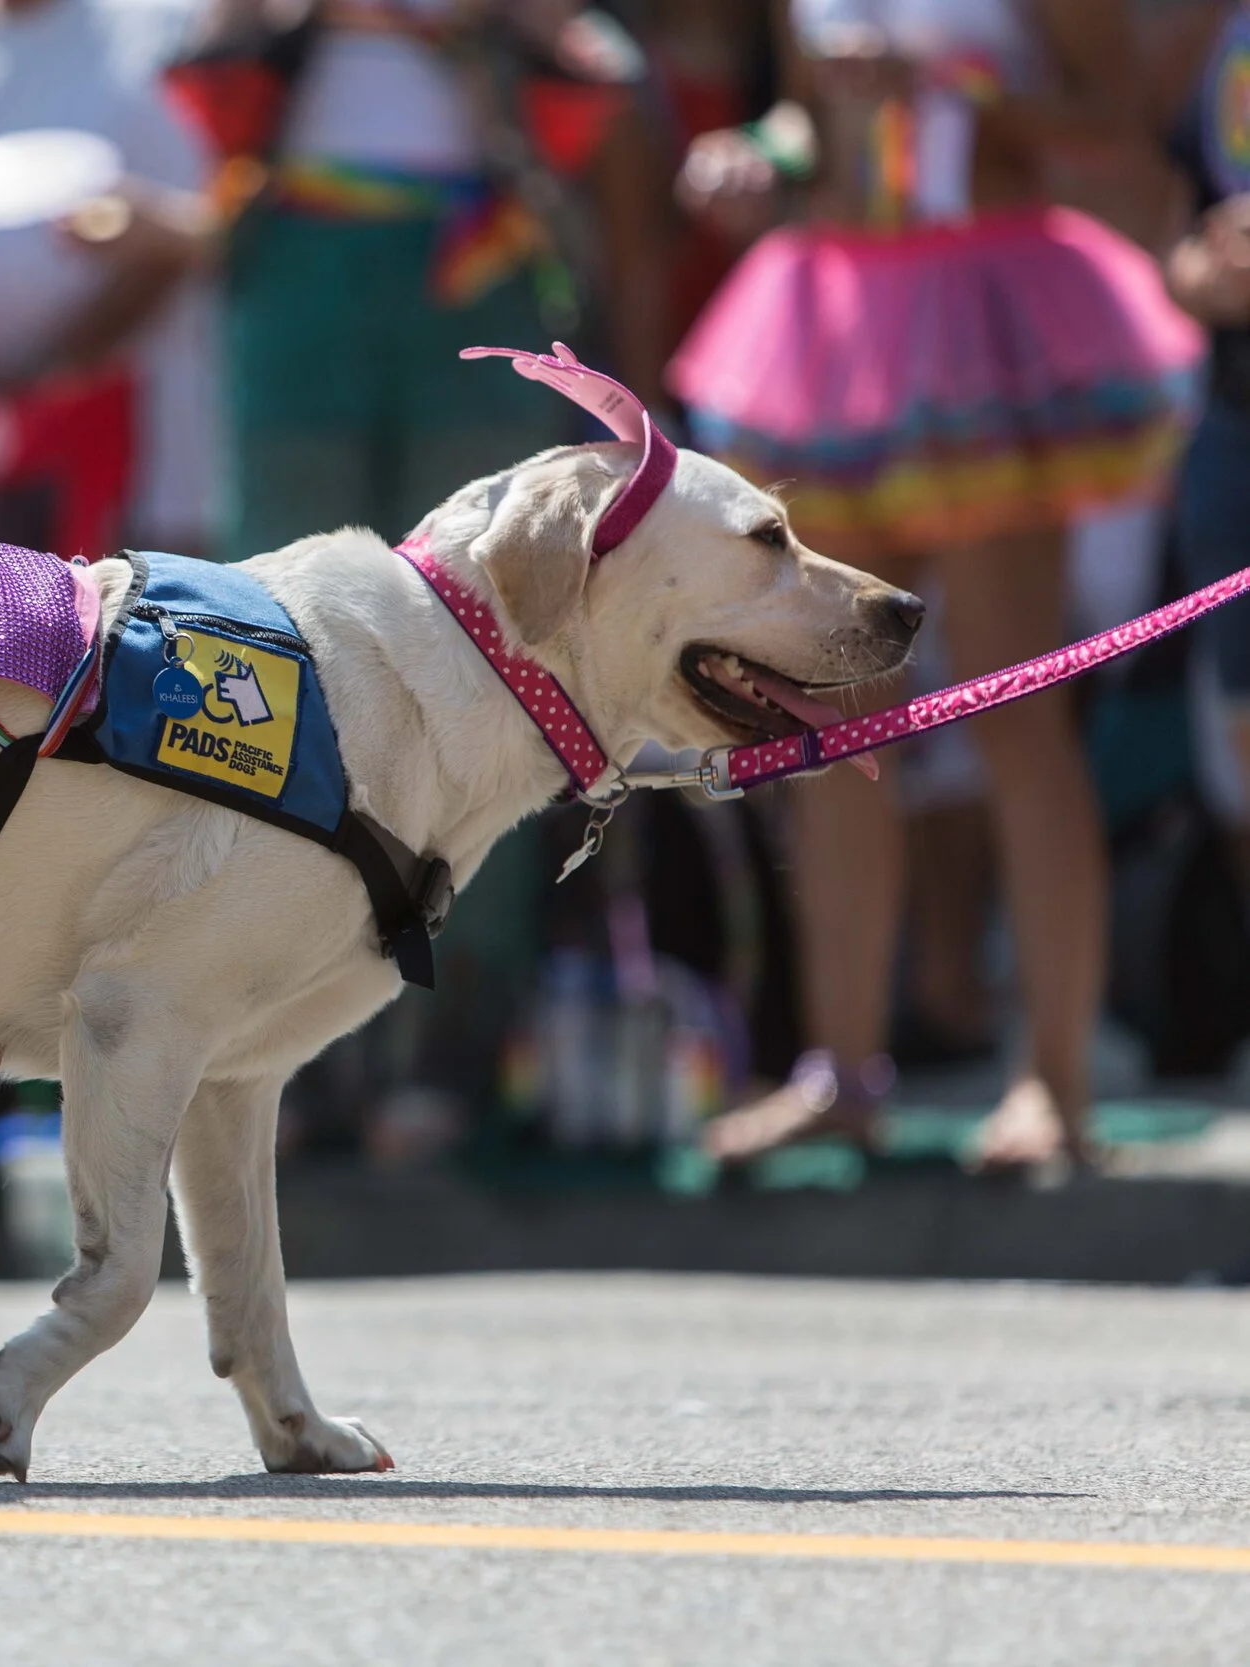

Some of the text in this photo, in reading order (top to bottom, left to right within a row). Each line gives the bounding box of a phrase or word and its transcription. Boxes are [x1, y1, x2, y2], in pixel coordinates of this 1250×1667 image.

[159, 692, 198, 704] KHALEESI
[167, 722, 232, 763] PADS
[234, 740, 273, 761] PACIFIC
[229, 759, 256, 776] DOGS
[231, 750, 284, 776] ASSISTANCE
